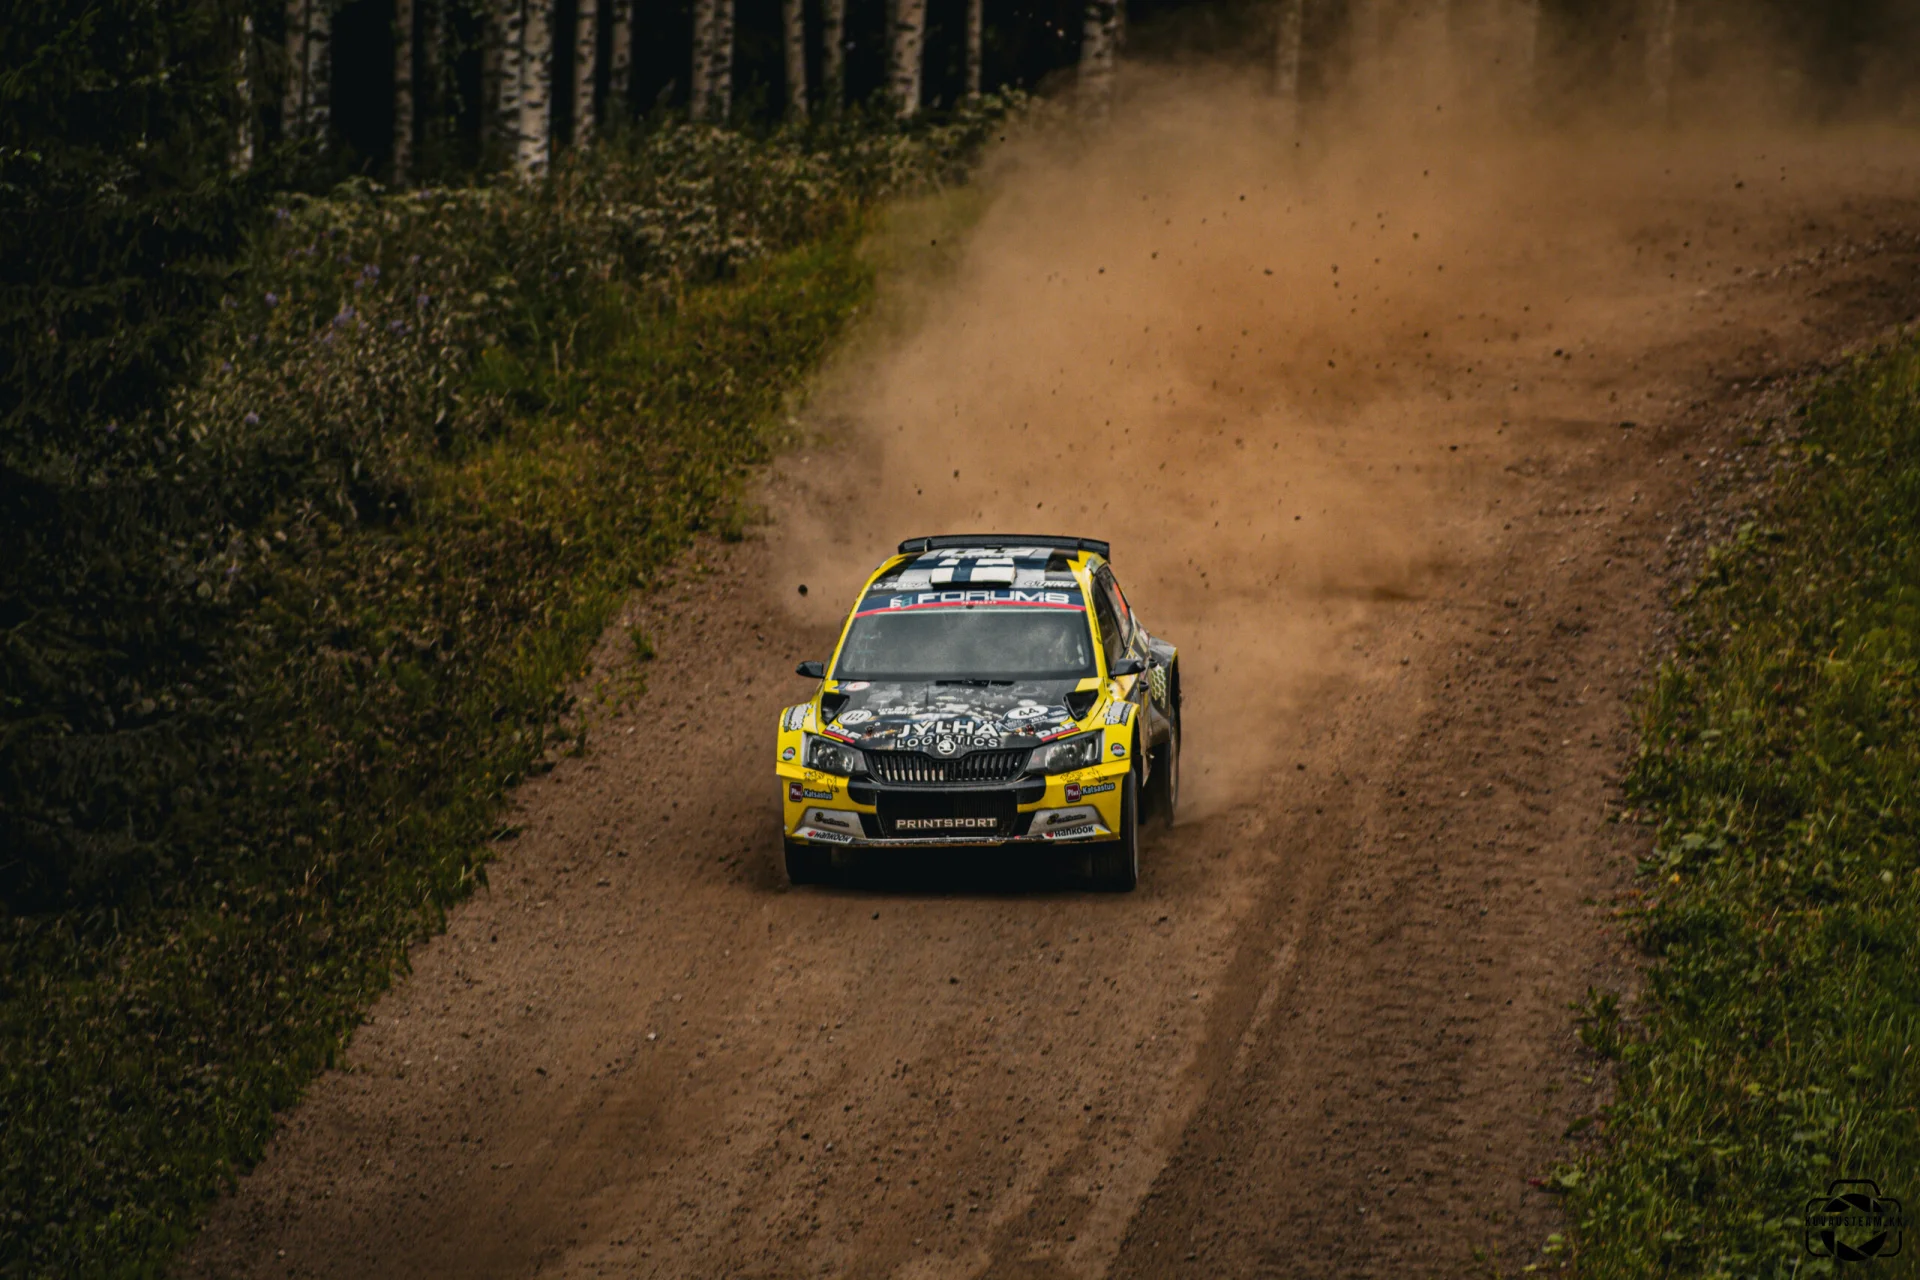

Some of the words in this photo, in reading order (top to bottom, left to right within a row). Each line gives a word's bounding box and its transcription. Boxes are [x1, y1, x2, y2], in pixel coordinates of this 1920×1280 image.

[918, 590, 1070, 604] FORUM8
[1019, 707, 1040, 717] 44
[825, 724, 862, 739] DAF
[897, 720, 999, 738] JYLHÄ
[1036, 722, 1077, 737] DAF
[897, 734, 998, 748] LOGISTICS
[804, 789, 832, 799] Katsastus
[1067, 788, 1079, 797] Plus
[1082, 783, 1115, 795] Katsastus
[896, 818, 997, 829] PRINTSPORT
